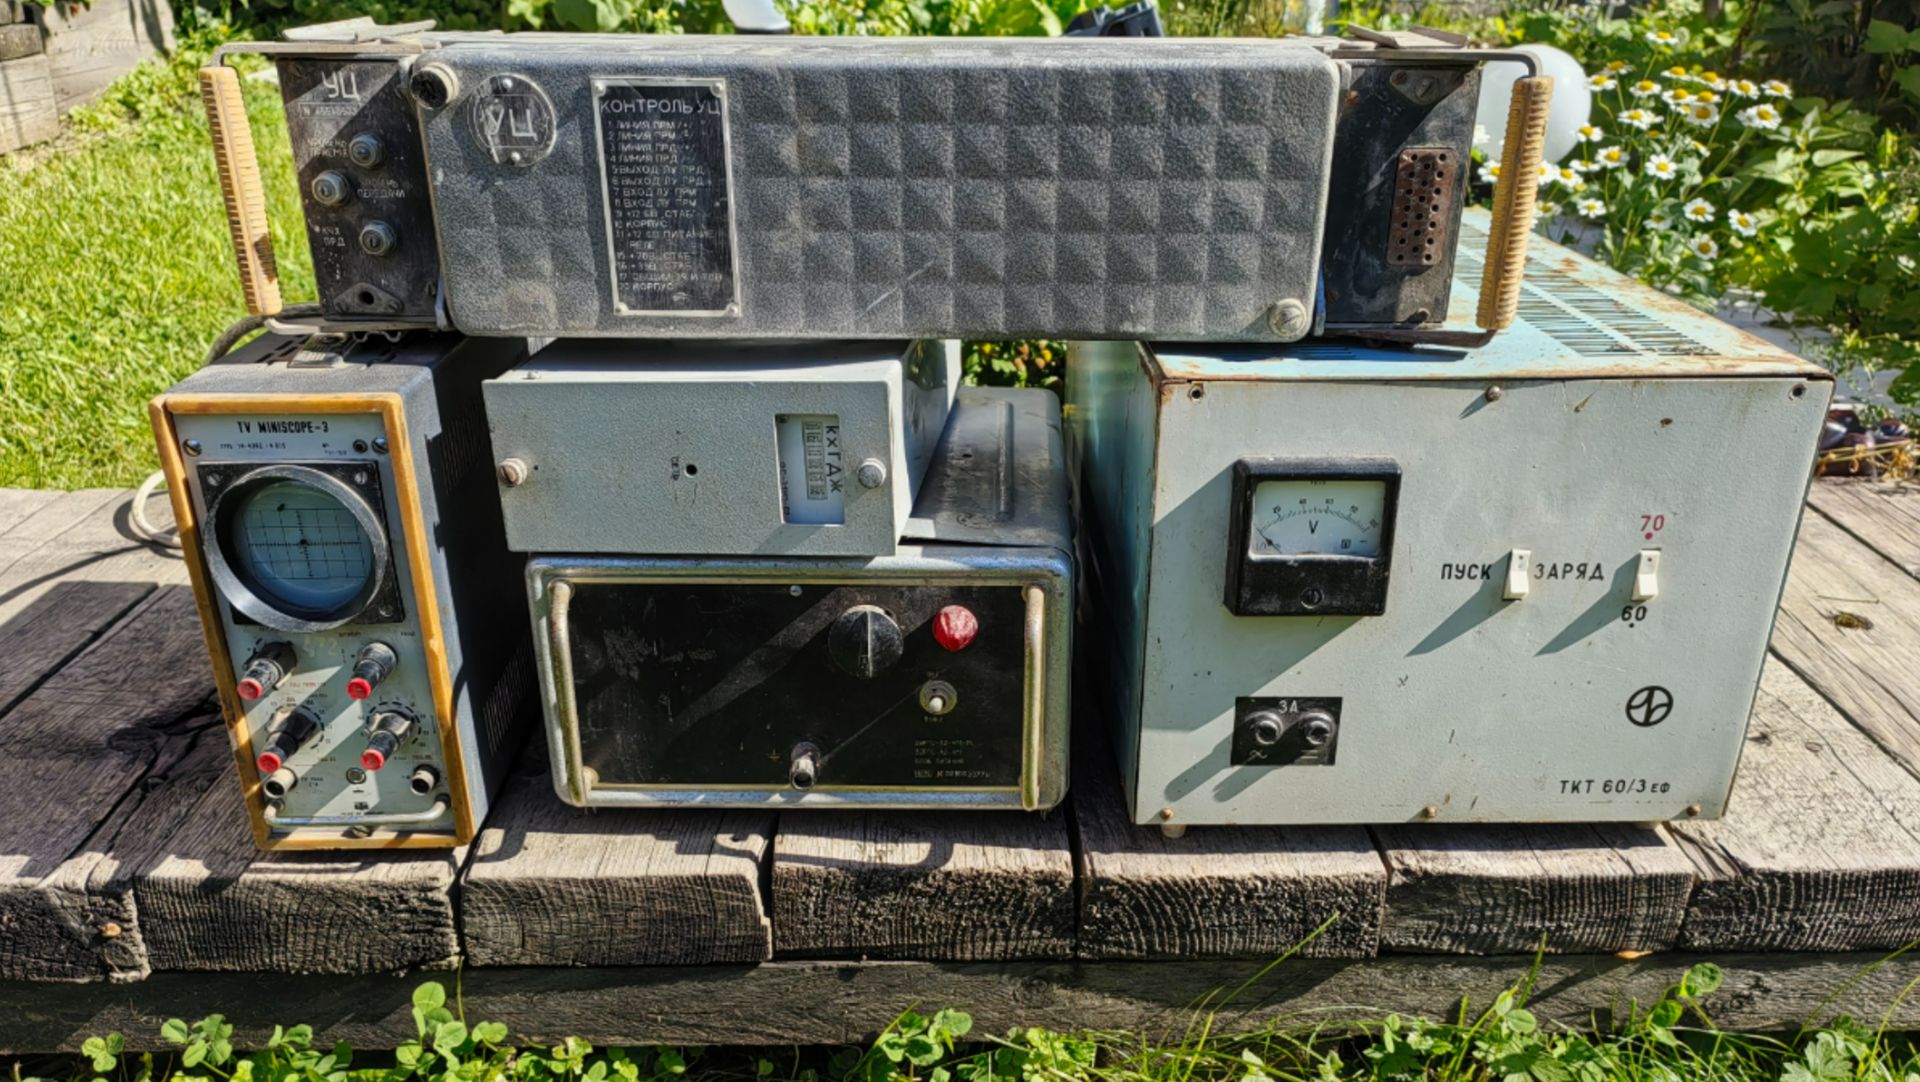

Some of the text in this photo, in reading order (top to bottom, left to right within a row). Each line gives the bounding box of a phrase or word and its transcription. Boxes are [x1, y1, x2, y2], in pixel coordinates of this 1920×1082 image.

[321, 71, 361, 101] УЦ
[600, 99, 721, 116] КОНТРОЛЬ УЦ
[485, 108, 538, 142] УЦ
[616, 120, 651, 129] ЛИНИЯ
[653, 120, 676, 129] ПРМ
[618, 131, 652, 140] ЛИНИЯ
[654, 131, 677, 140] ПРМ
[618, 143, 652, 152] ЛИНИЯ
[655, 143, 678, 153] ПРД
[618, 154, 653, 163] ЛИНИЯ
[655, 154, 678, 164] ПРД
[620, 165, 659, 175] ВЫХОД
[682, 165, 704, 175] ПРД
[621, 176, 660, 185] ВЫХОД
[682, 176, 704, 186] ПРД
[623, 187, 653, 197] ВХОД
[674, 187, 697, 196] ПРМ
[623, 199, 653, 208] ВХОД
[675, 198, 697, 207] ПРМ
[626, 219, 669, 228] КОРПУС
[632, 282, 674, 291] КОРПУС
[237, 420, 329, 434] TV MINISCOPE-3
[1308, 519, 1320, 535] V
[1640, 514, 1665, 532] 70
[1440, 562, 1492, 580] ПУСК
[1533, 562, 1604, 581] ЗАРЯД
[1621, 605, 1648, 622] 60
[1278, 700, 1299, 714] 3А
[1559, 779, 1595, 794] ТКТ
